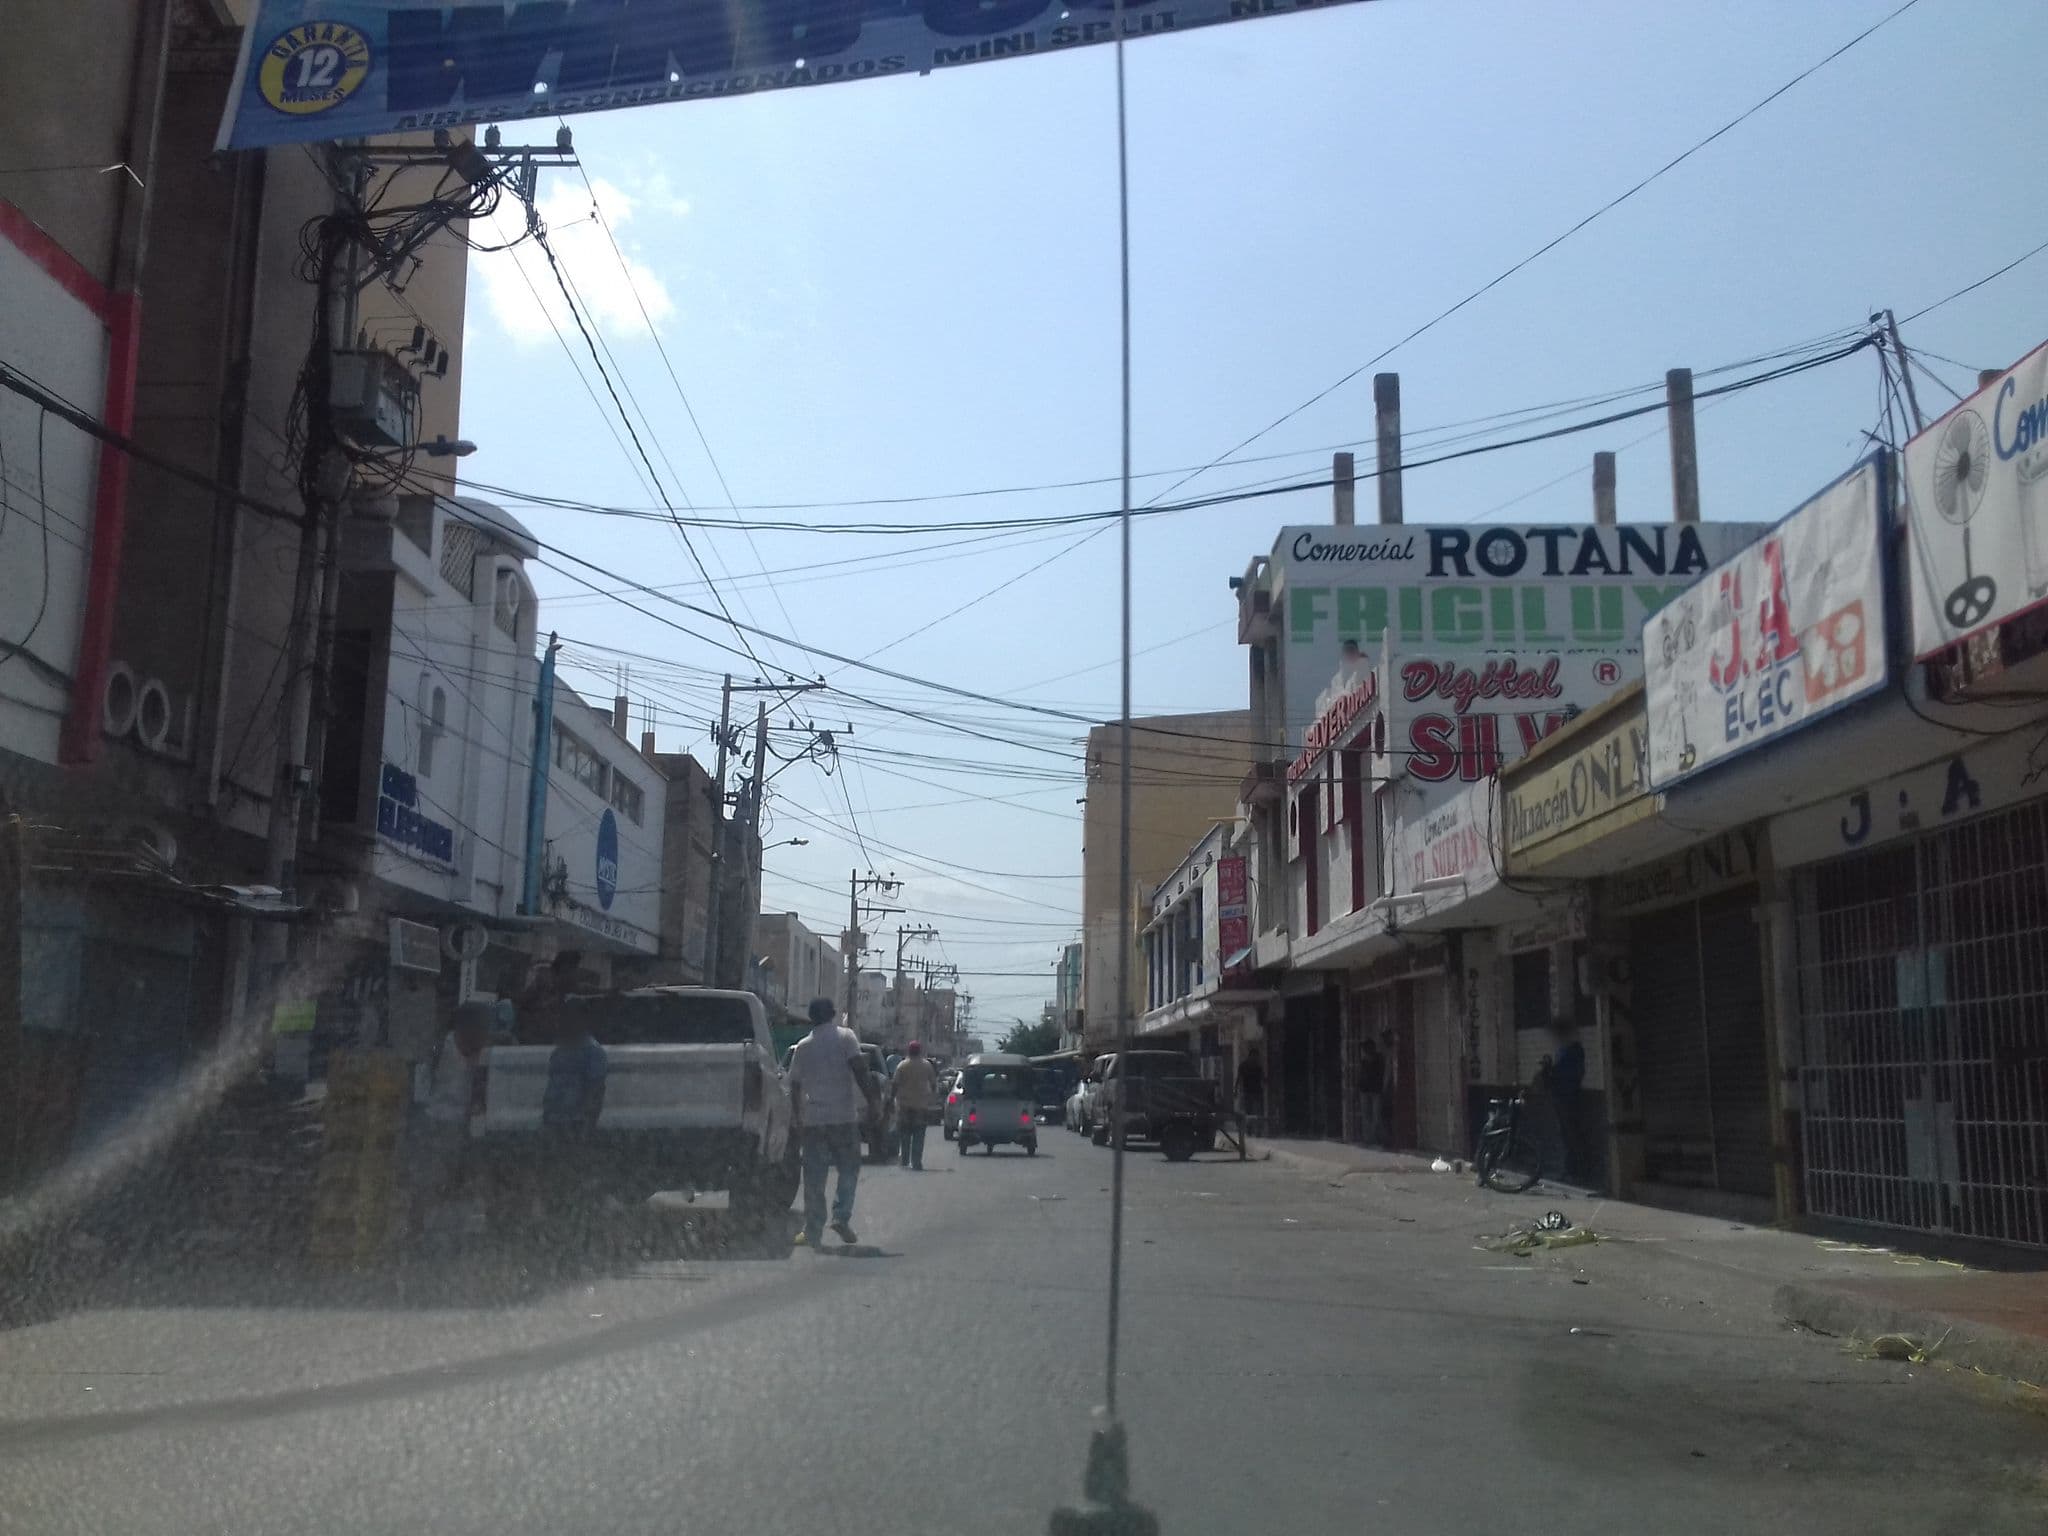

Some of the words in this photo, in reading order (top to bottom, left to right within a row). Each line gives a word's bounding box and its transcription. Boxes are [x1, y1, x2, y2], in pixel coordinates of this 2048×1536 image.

[932, 31, 1036, 66] MINI
[1050, 10, 1178, 47] SPLIT
[296, 49, 339, 87] 12
[1292, 532, 1415, 562] Comercial
[1425, 525, 1709, 577] ROTANA
[1400, 655, 1564, 714] Digital
